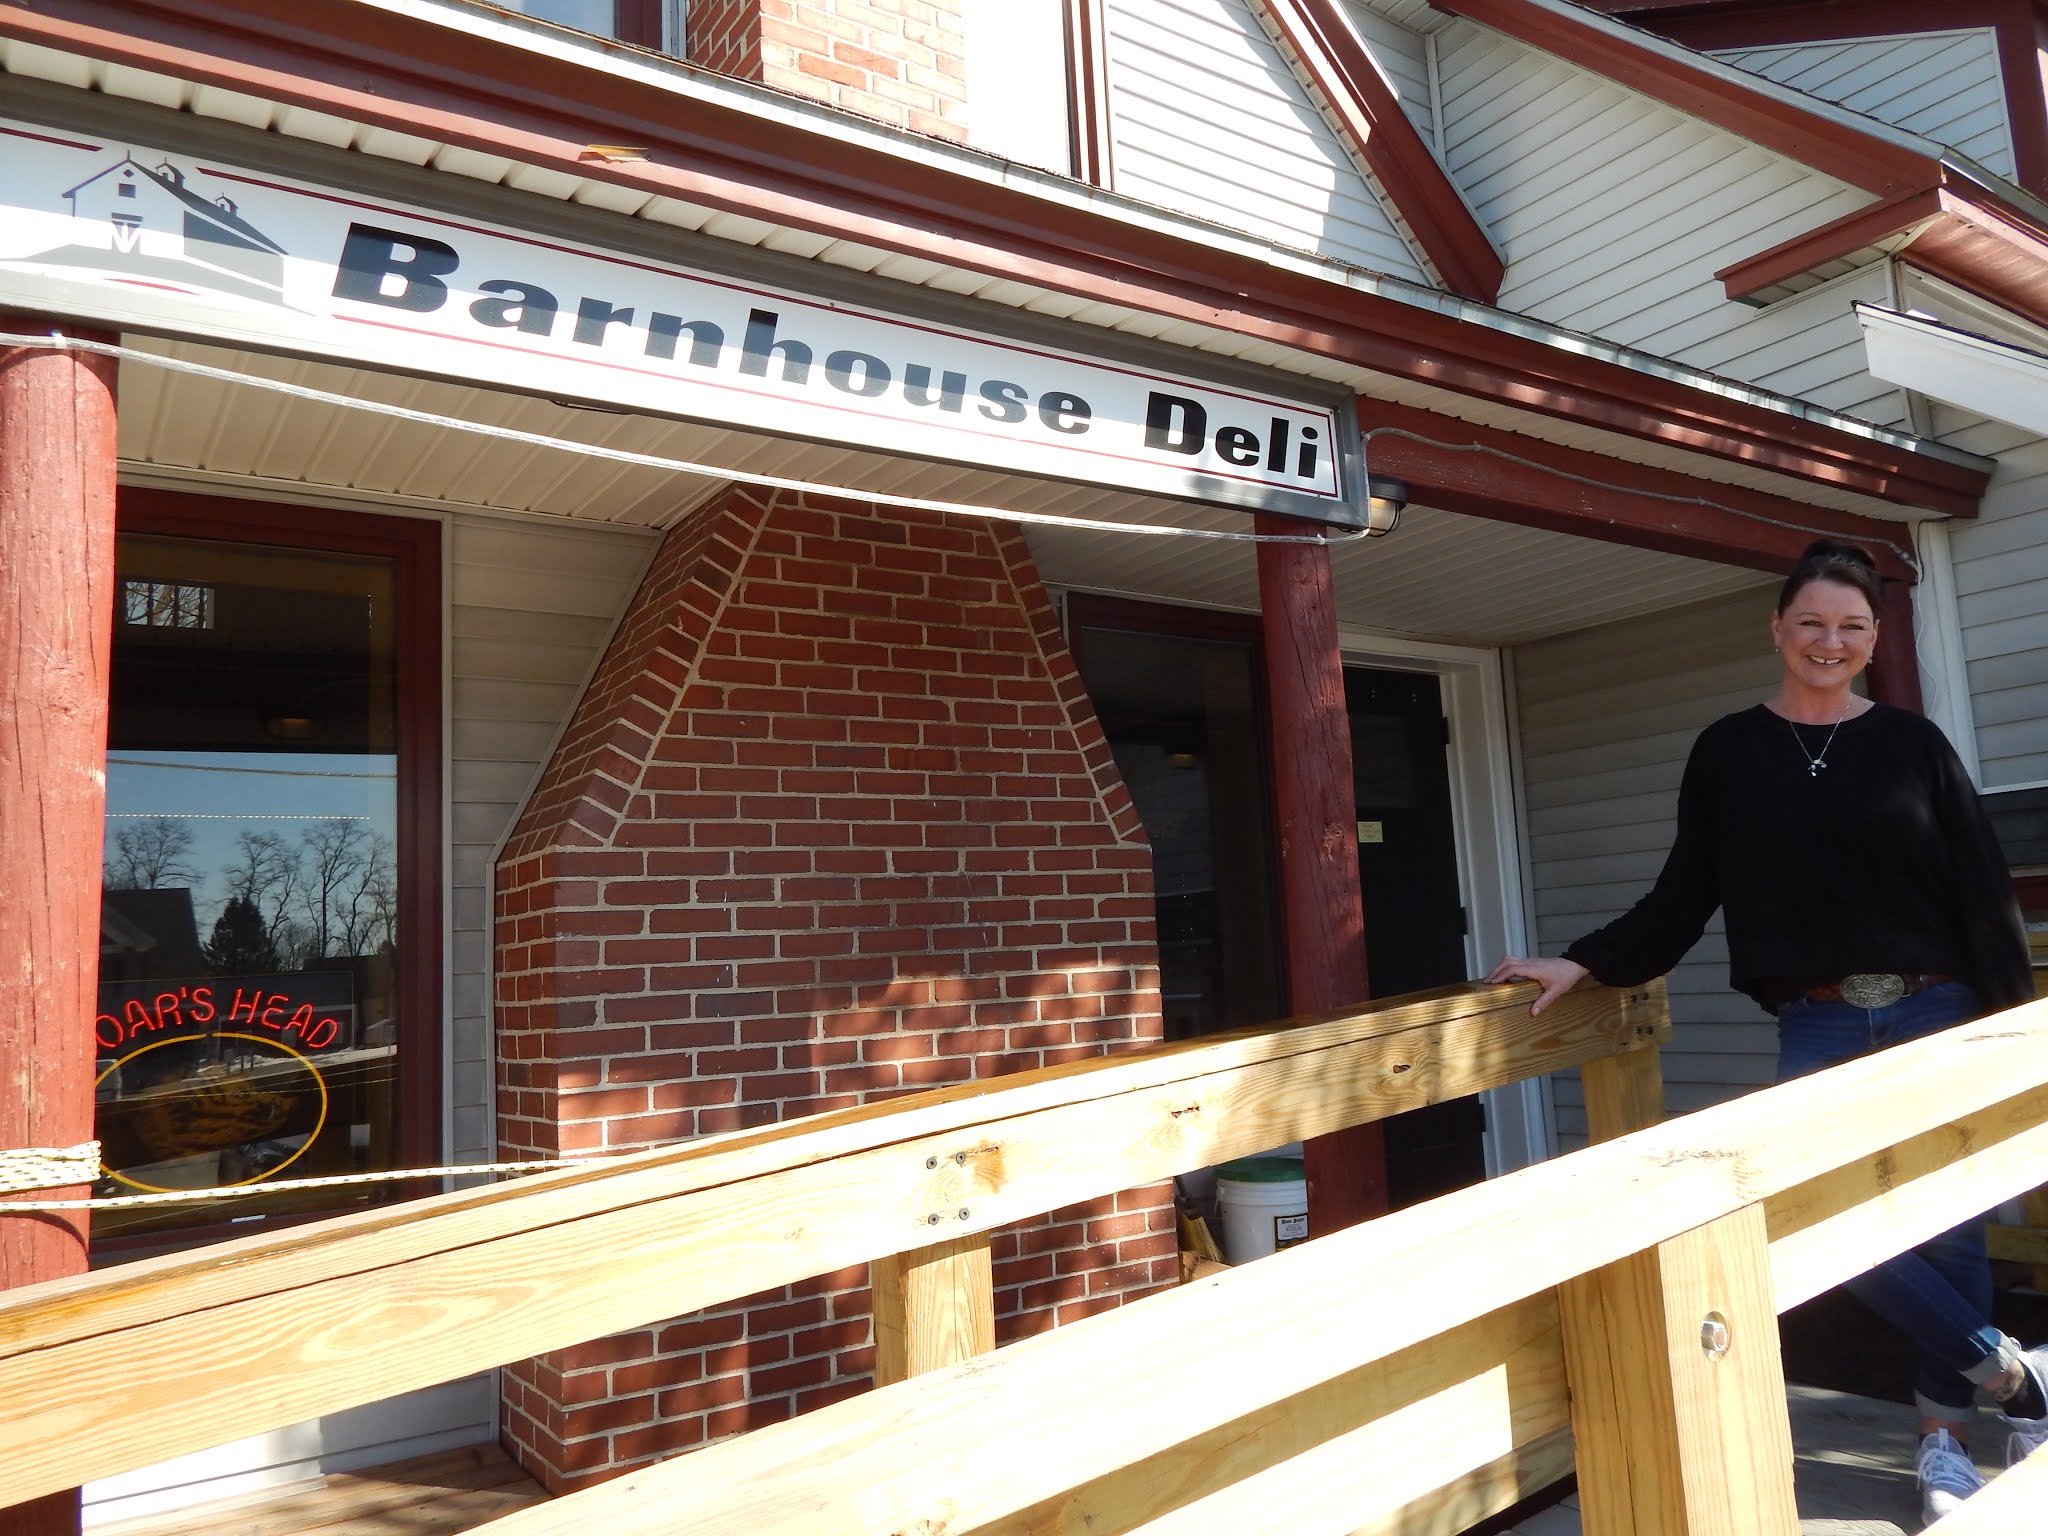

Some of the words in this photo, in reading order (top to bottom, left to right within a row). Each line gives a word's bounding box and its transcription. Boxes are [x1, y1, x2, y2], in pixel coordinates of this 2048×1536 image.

[332, 222, 1092, 435] Barnhouse
[1144, 390, 1320, 480] Deli
[96, 986, 216, 1048] OAR'S
[228, 988, 339, 1048] HEAD
